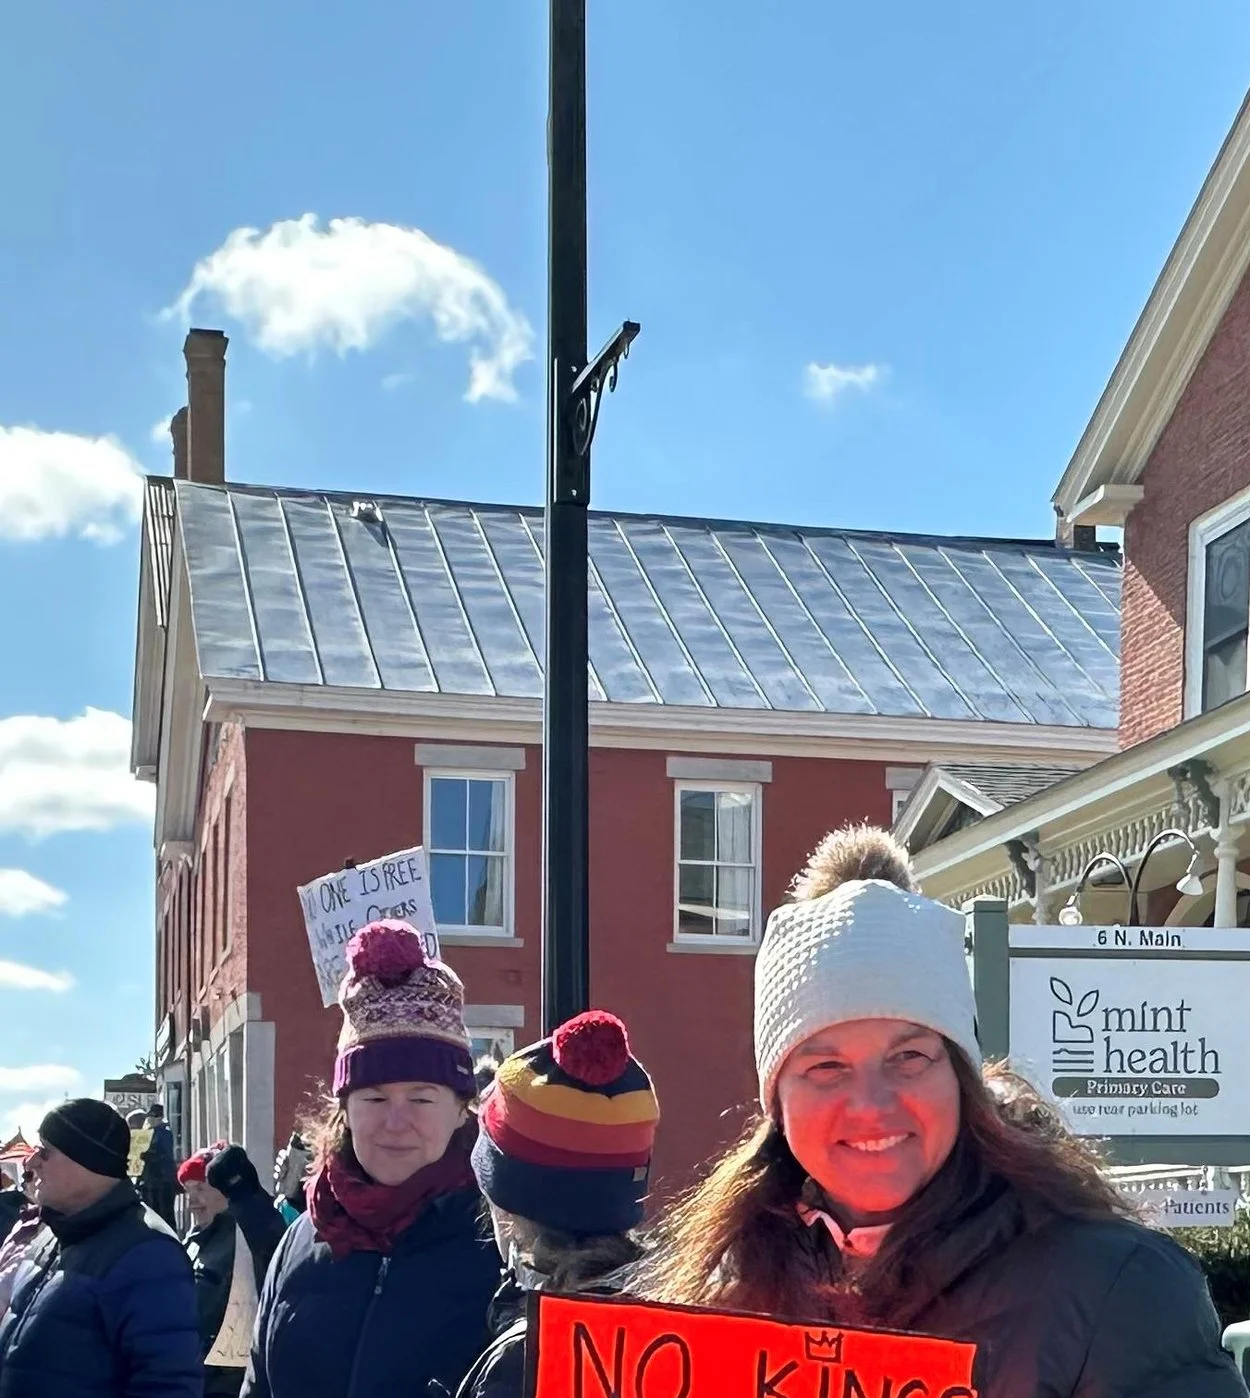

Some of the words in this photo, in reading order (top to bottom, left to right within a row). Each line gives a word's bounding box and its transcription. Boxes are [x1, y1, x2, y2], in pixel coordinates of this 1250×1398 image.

[359, 868, 381, 896] IS
[1097, 929, 1107, 945] 6
[1114, 929, 1132, 946] N.
[1139, 929, 1182, 947] Main
[1101, 999, 1192, 1033] mint
[1103, 1036, 1222, 1074] health
[1086, 1079, 1148, 1097] Primary
[1151, 1080, 1186, 1095] Care
[1098, 1105, 1123, 1116] rear
[1127, 1102, 1178, 1118] parking
[1180, 1102, 1199, 1116] lot
